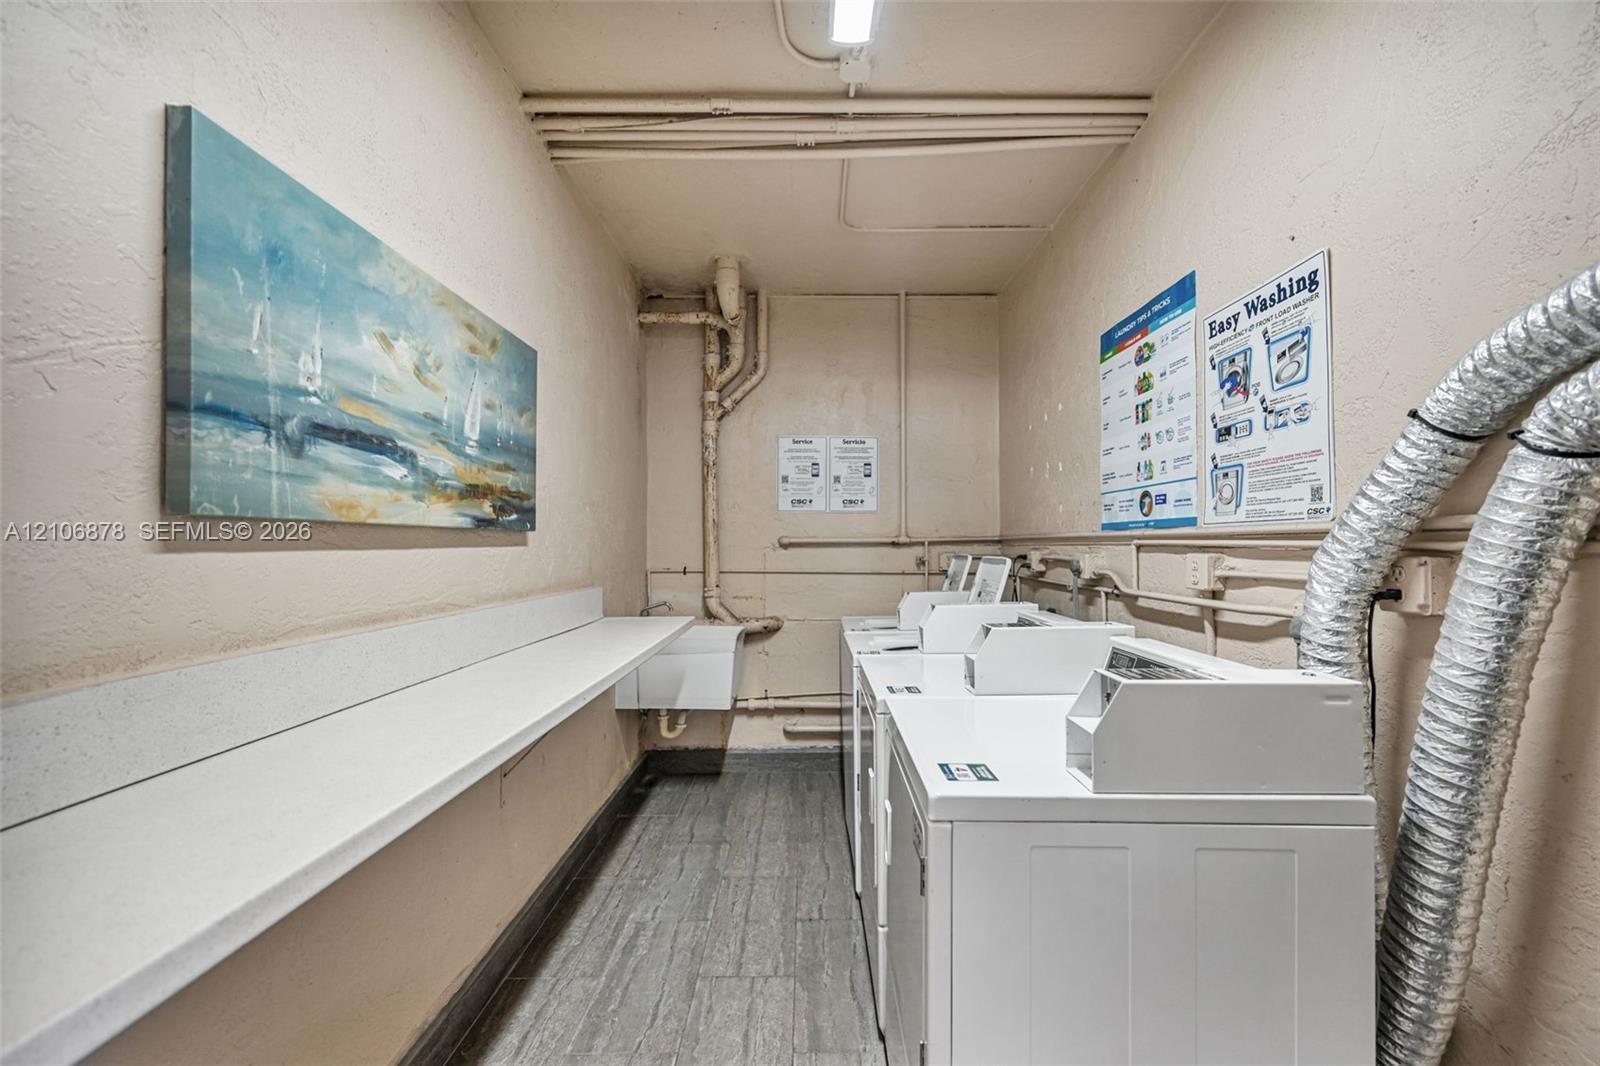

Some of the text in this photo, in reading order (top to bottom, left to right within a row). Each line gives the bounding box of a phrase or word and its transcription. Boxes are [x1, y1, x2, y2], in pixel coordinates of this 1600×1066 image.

[1114, 320, 1137, 339] LAUNDRY
[1136, 312, 1147, 326] TIPS
[1151, 295, 1171, 313] TRICKS
[1208, 311, 1240, 339] Easy
[1243, 268, 1320, 319] Washing
[1209, 328, 1248, 350] HIGH-EFFICIENCY
[1255, 314, 1274, 328] FRONT
[1274, 306, 1292, 319] LOAD
[1292, 292, 1320, 311] WASHER
[1306, 507, 1325, 515] CSC
